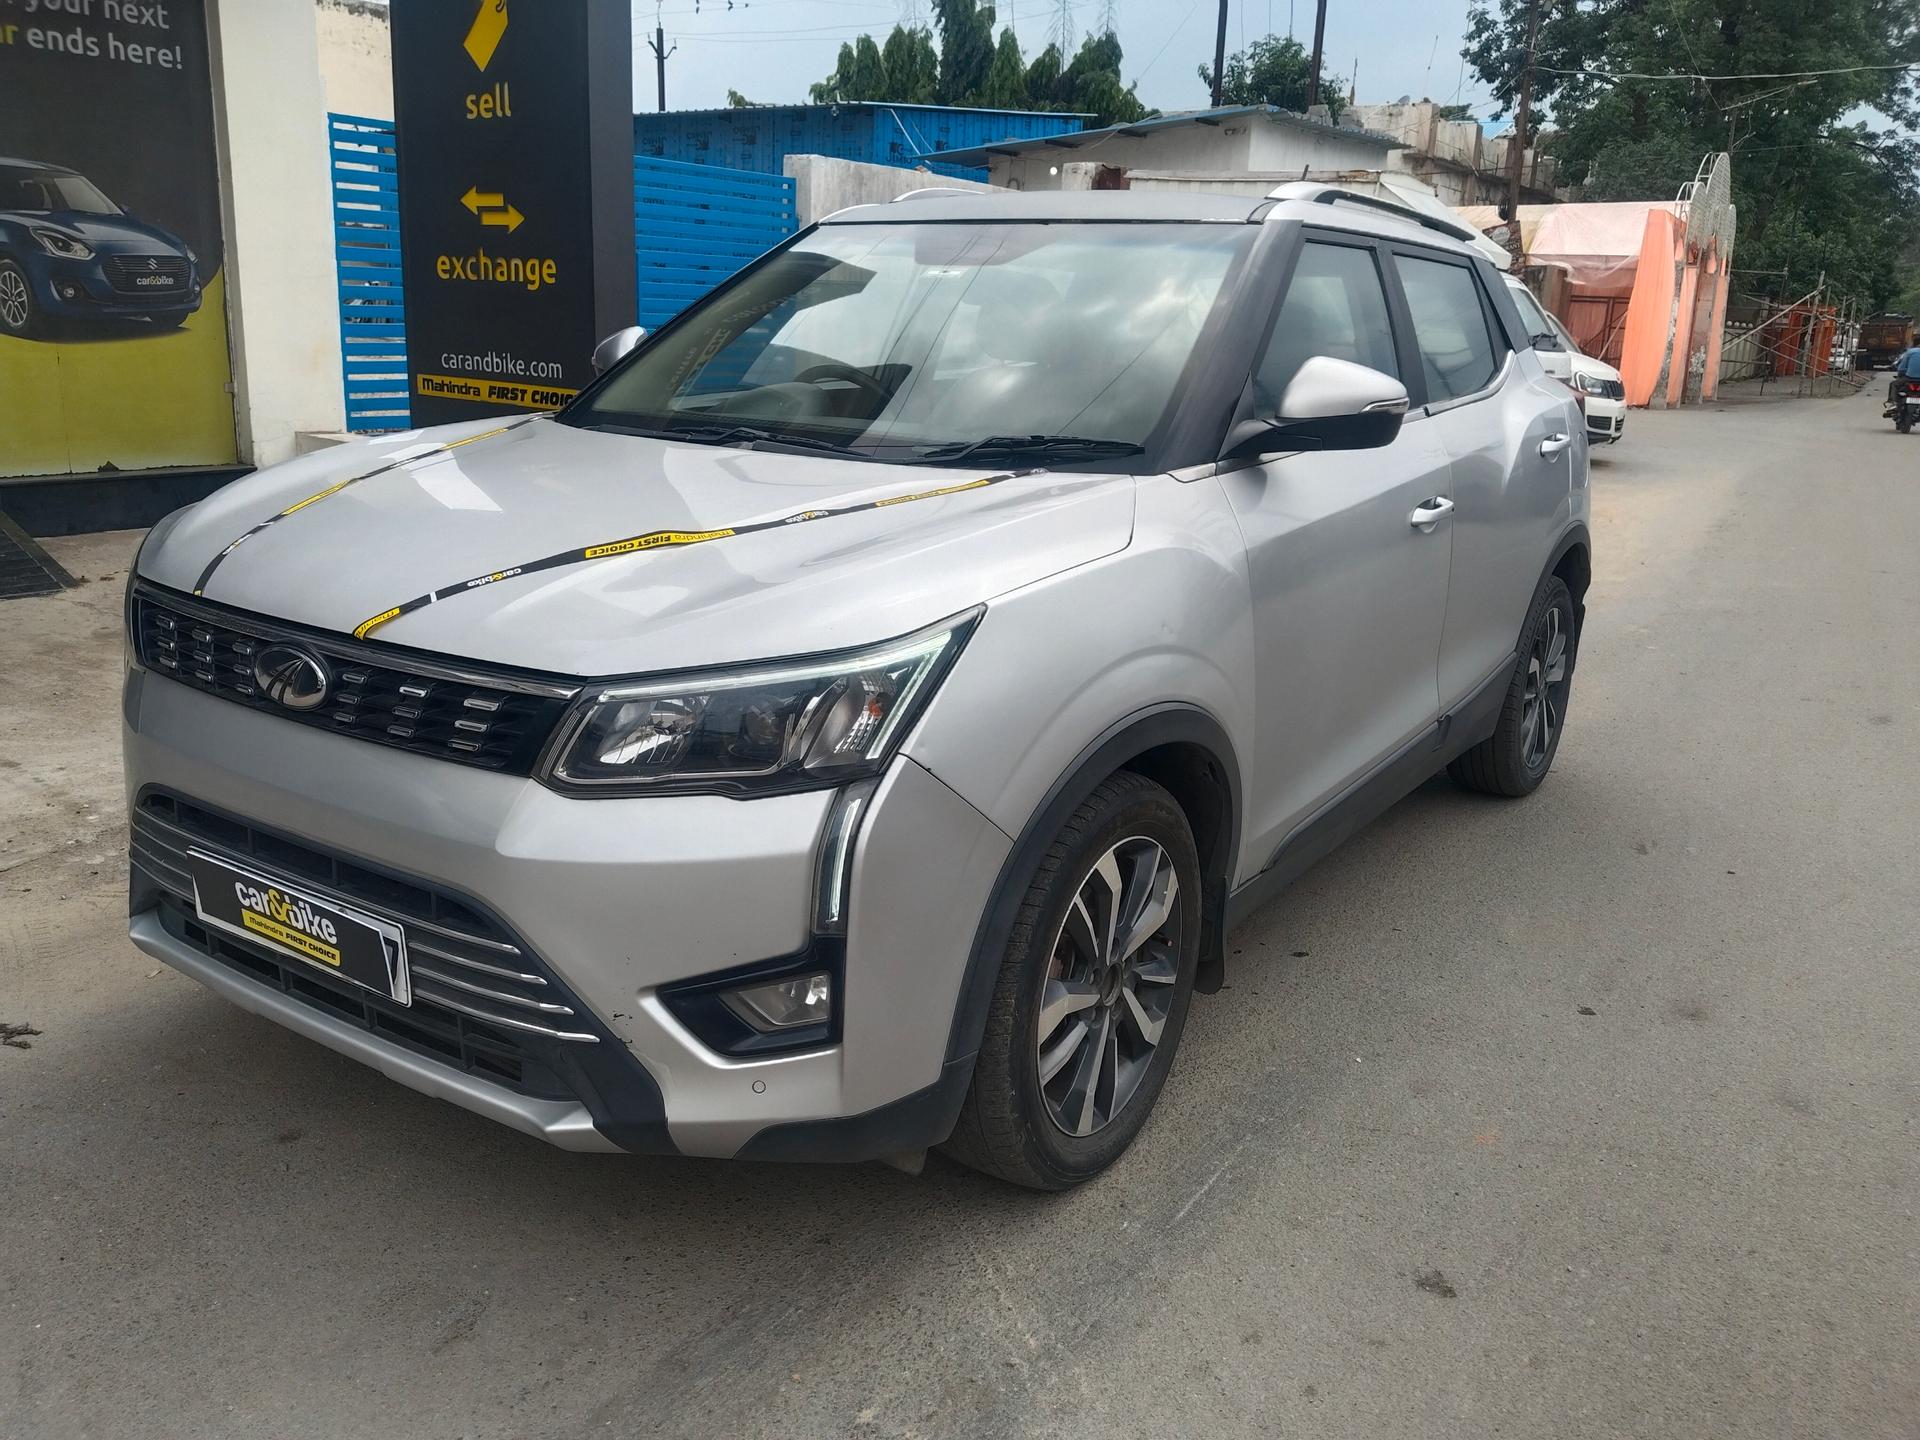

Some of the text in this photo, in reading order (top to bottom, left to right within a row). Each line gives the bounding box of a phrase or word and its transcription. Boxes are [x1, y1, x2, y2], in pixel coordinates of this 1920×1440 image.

[104, 0, 170, 29] next
[26, 27, 100, 57] ends
[108, 32, 183, 70] here!
[465, 81, 512, 120] sell
[136, 275, 174, 285] car&bike
[436, 247, 557, 291] exchange
[441, 351, 563, 379] carandbike.com
[422, 377, 577, 406] Mahindra FIRST CHOIC
[590, 543, 635, 556] CHOICE
[636, 534, 671, 547] FIRST
[467, 568, 522, 587] car&bike
[234, 881, 338, 945] car&bike
[285, 931, 308, 948] FIRST
[308, 942, 337, 961] CHOICE
